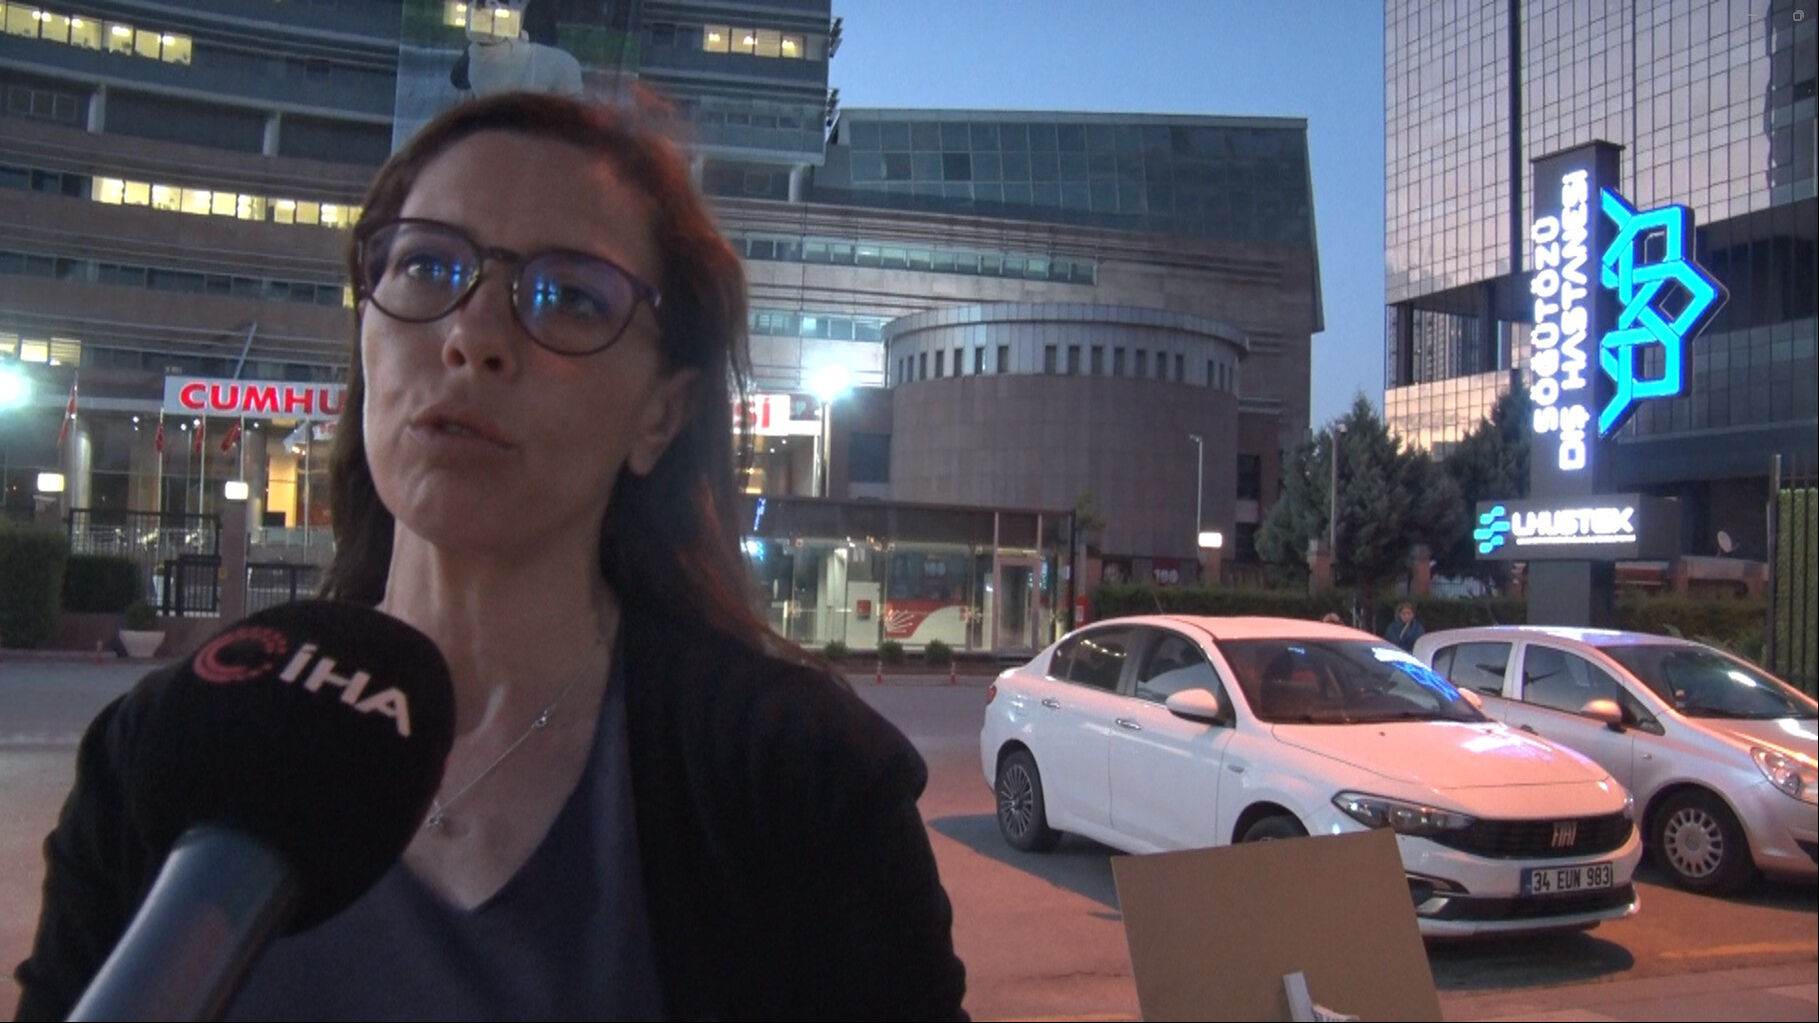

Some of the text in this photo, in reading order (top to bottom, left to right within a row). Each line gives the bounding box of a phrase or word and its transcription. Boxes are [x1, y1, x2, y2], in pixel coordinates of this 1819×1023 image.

[1561, 169, 1588, 390] HASTANESİ
[1534, 866, 1610, 892] 34 EUN 983
